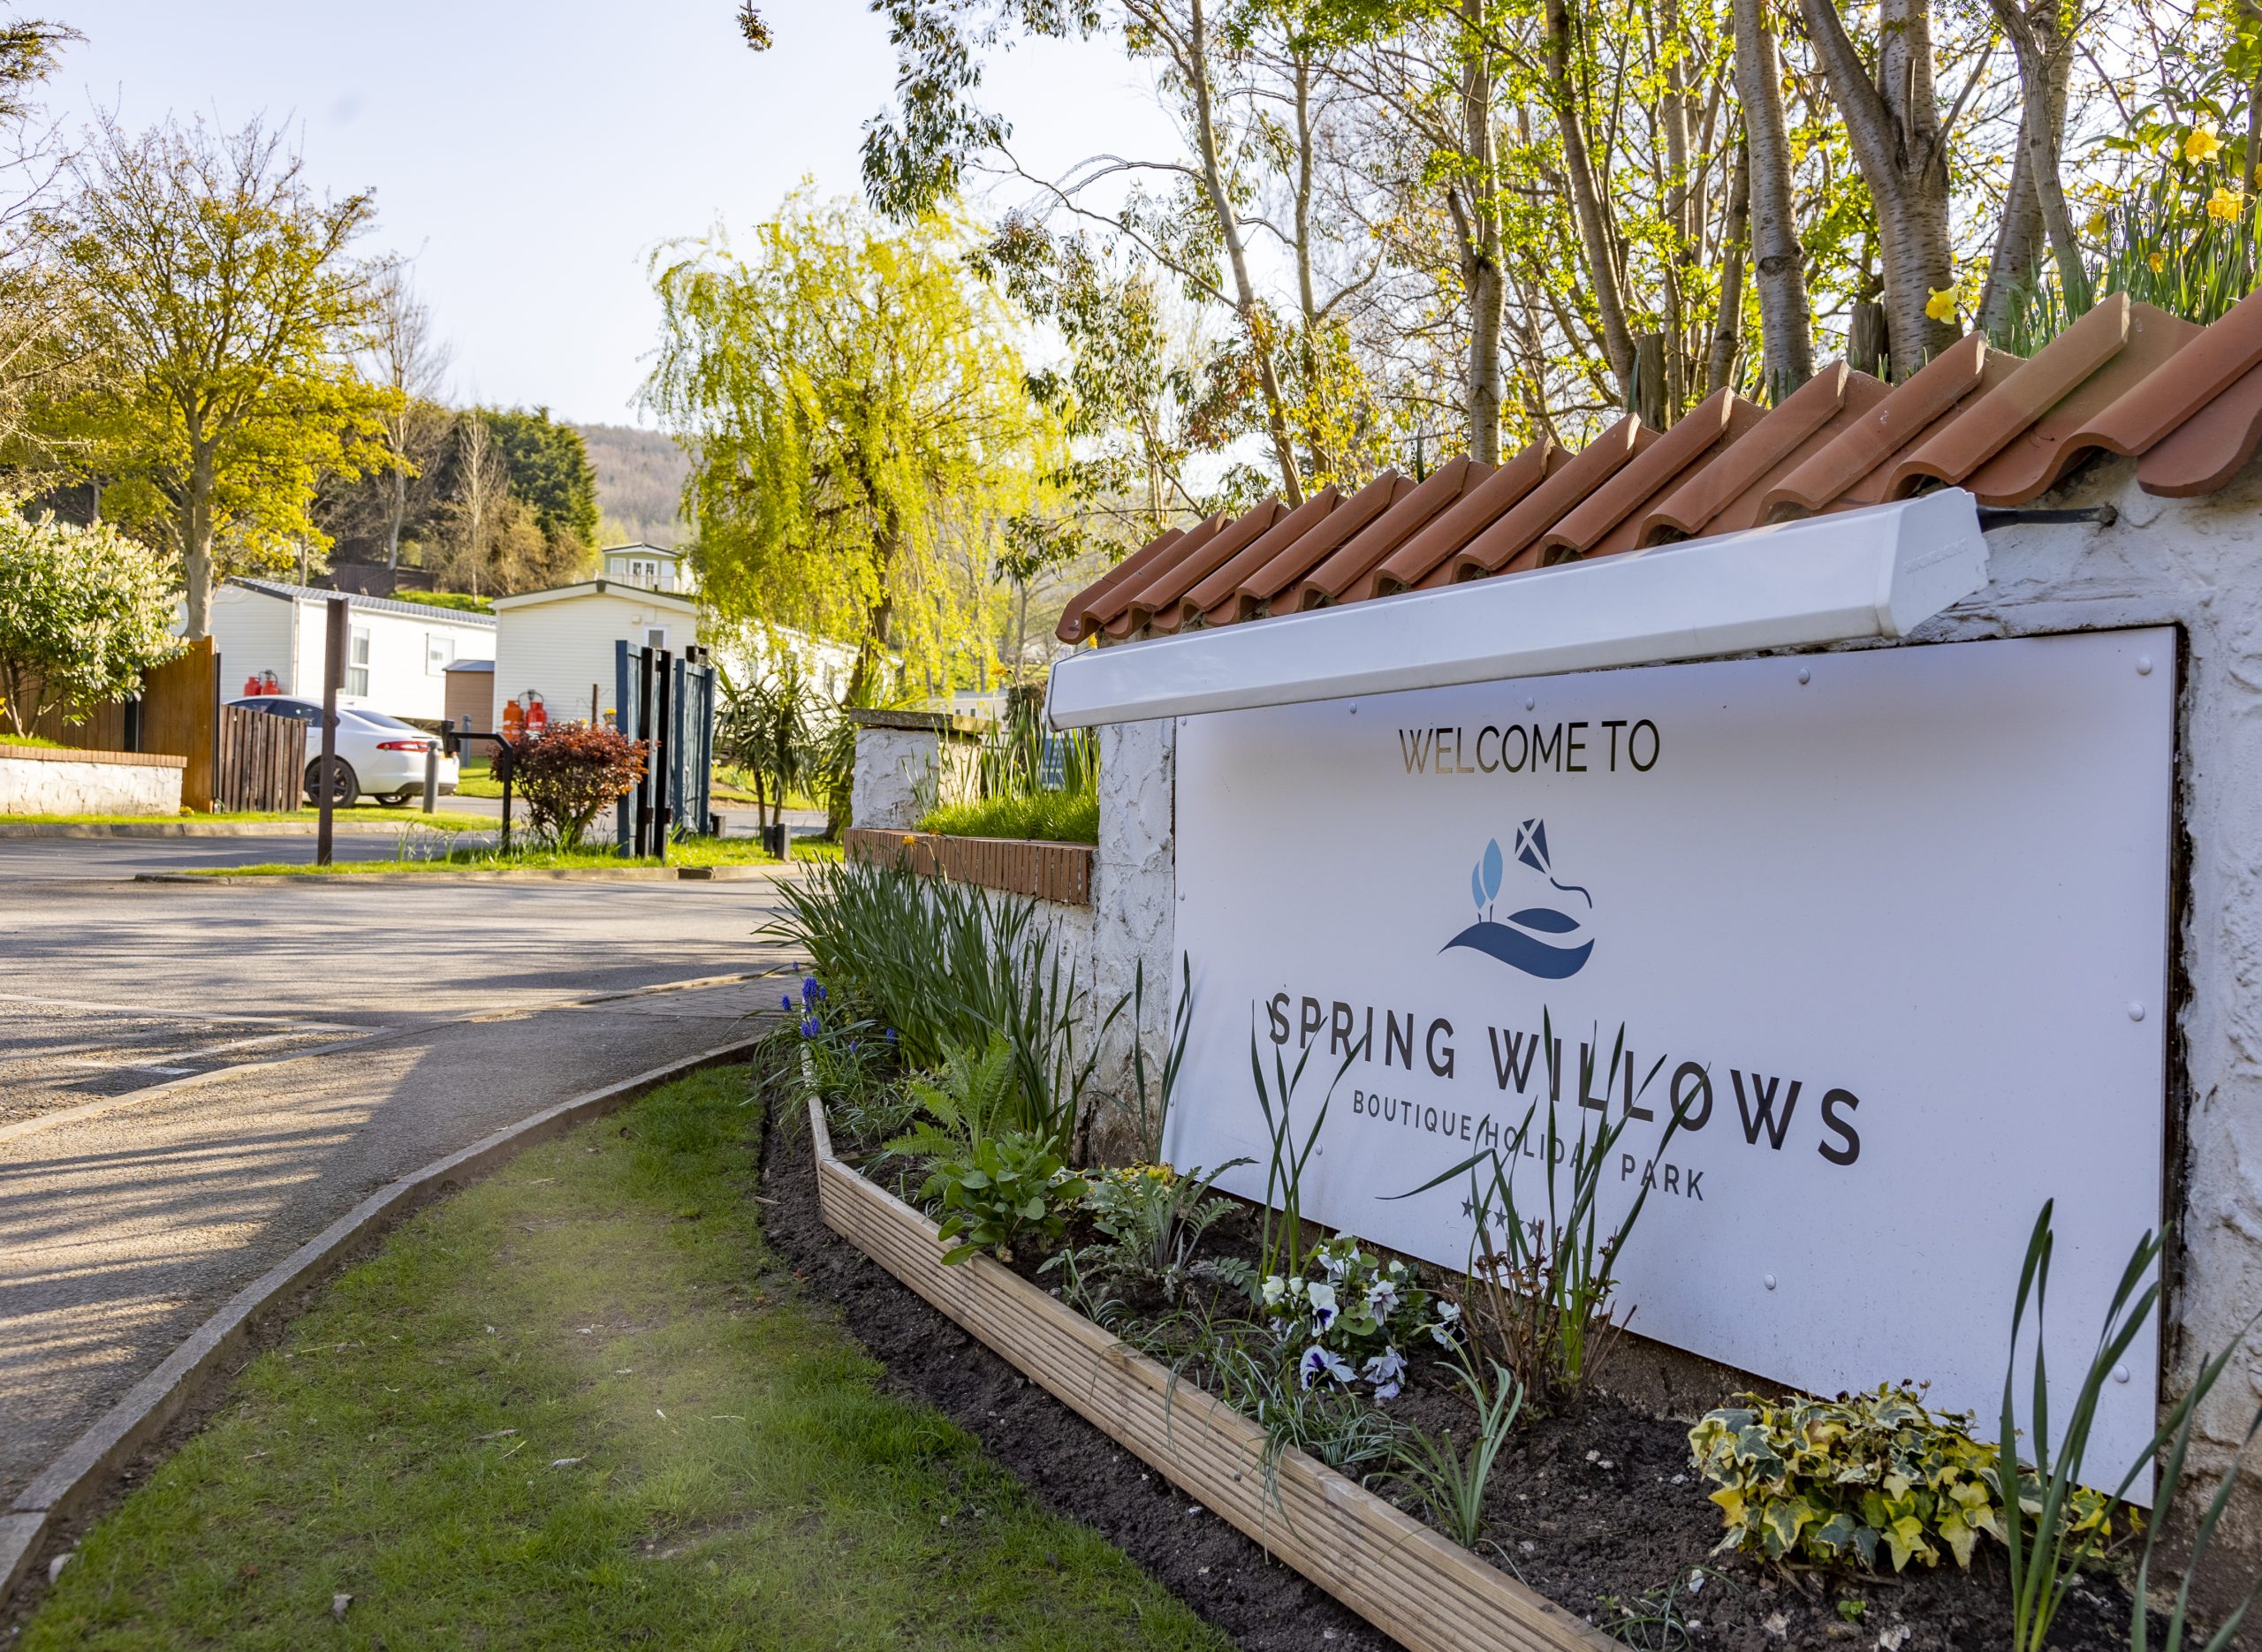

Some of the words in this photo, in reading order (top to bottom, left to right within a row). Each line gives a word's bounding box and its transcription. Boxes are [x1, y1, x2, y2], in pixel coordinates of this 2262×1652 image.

[1399, 722, 1589, 774] WELCOME
[1601, 719, 1660, 772] TO
[1270, 992, 1455, 1080] SPRING
[1488, 1026, 1861, 1166] WILLOWS
[1353, 1089, 1472, 1141] BOUTIQUE
[1621, 1153, 1704, 1201] PARK
